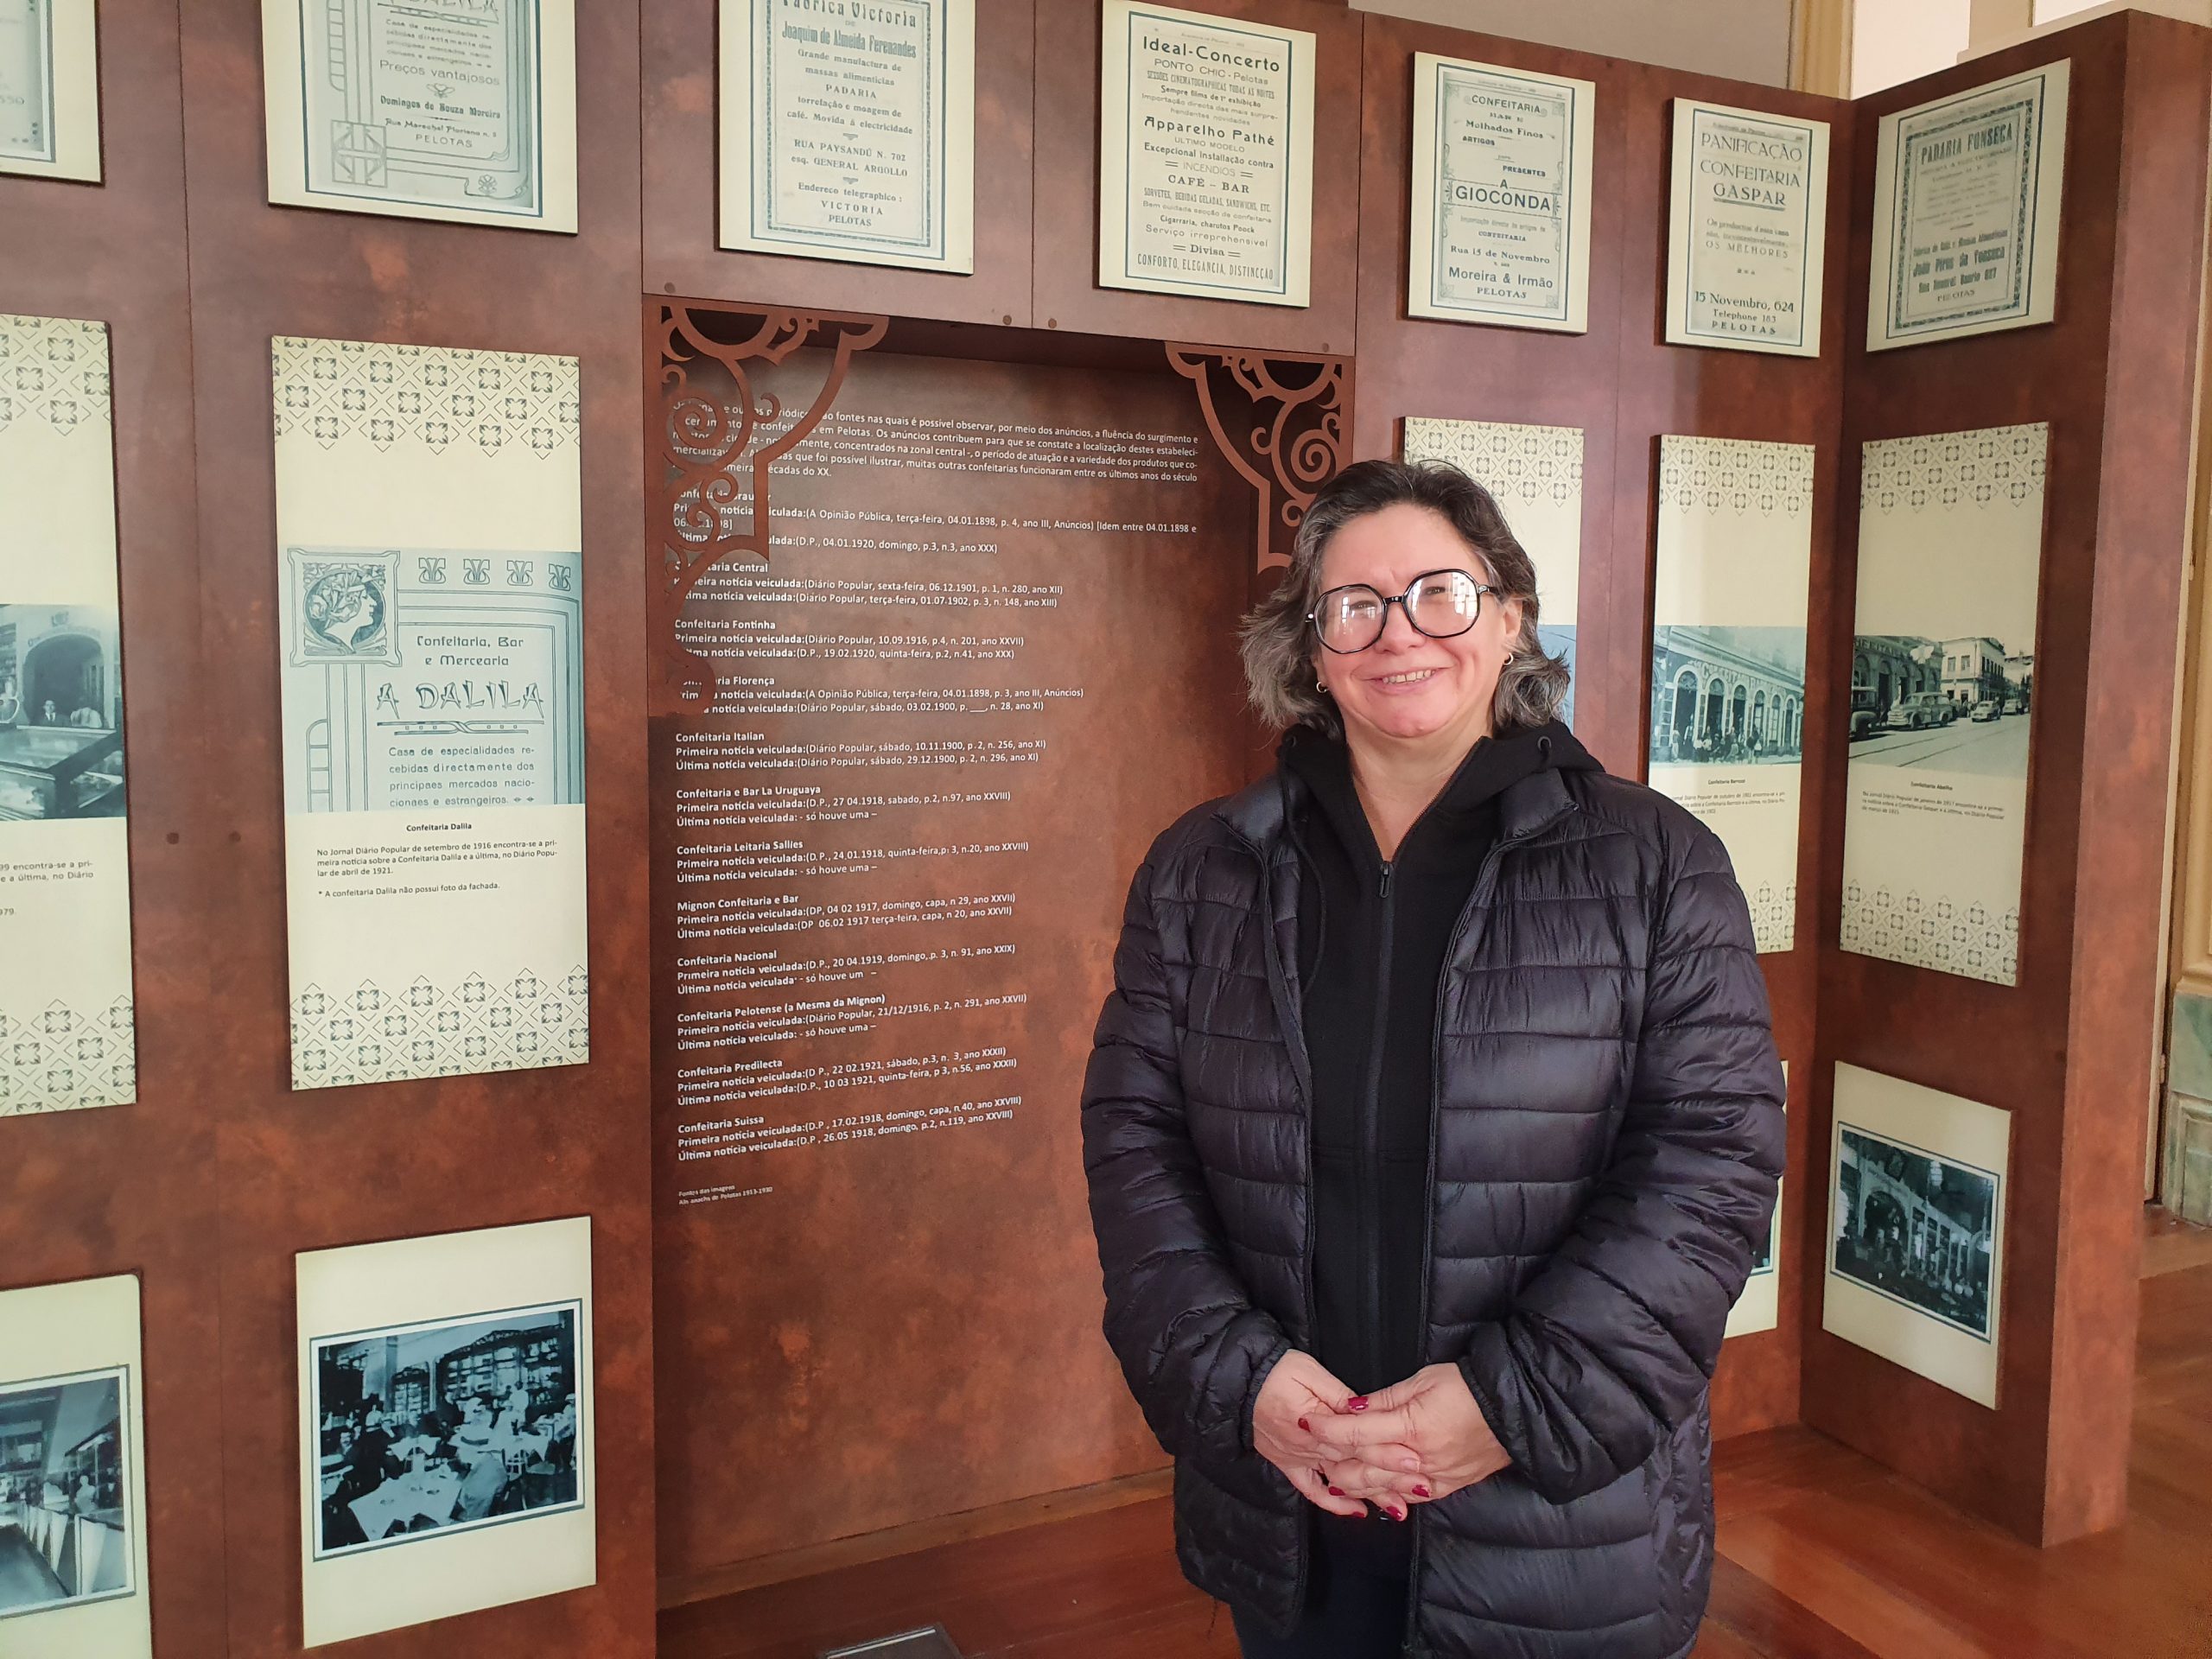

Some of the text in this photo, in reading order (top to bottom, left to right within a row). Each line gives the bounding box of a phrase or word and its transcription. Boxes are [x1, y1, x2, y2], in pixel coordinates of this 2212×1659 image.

[852, 4, 915, 28] Victoria
[1144, 35, 1279, 73] Ideal-Concerto
[380, 59, 499, 86] Preços vantajosos
[1154, 58, 1193, 74] PONTO
[1199, 66, 1226, 79] CHIC
[826, 84, 876, 99] PADARIA
[1471, 94, 1541, 113] CONFEITARIA
[1145, 116, 1274, 146] Apparelho Pathé
[416, 133, 473, 148] PELOTAS
[1700, 132, 1802, 162] PANIFICAÇÃO
[1922, 123, 2012, 165] PADARIA FONSECA
[1700, 160, 1801, 188] CONFEITARIA
[1168, 174, 1205, 188] CAFÉ
[1223, 181, 1249, 194] BAR
[1500, 179, 1508, 190] A
[1456, 185, 1551, 211] GIOCONDA
[1713, 182, 1786, 206] GASPAR
[821, 200, 882, 215] VICTORIA
[829, 214, 871, 227] PELOTAS
[1190, 244, 1224, 257] Divisa
[1451, 245, 1549, 264] Rua 15 de Novembro
[1449, 266, 1553, 289] Moreira & Irmão
[1477, 287, 1527, 299] PELOTAS
[1710, 292, 1770, 312] Novembro,
[1774, 301, 1794, 314] 624
[1712, 321, 1776, 335] PELOTAS
[676, 619, 775, 630] Confeitaria Fontinha
[417, 635, 524, 648] Confeitaria, Bar
[441, 655, 508, 666] Mercearia
[377, 679, 544, 720] A DALILA
[677, 731, 764, 742] Confeitaria Italian
[389, 747, 415, 757] Casa
[421, 747, 433, 756] de
[441, 745, 515, 757] especialidades
[677, 745, 719, 757] Primeira
[722, 744, 754, 755] notícia
[839, 742, 876, 755] Popular,
[879, 741, 913, 753] sábado,
[916, 741, 964, 753] 10.11.1900,
[968, 741, 985, 751] p.2,
[998, 740, 1014, 750] 256,
[1035, 739, 1046, 750] XI)
[390, 761, 534, 773] cebidas directamente dos
[391, 778, 535, 792] principaes mercados nacio-
[677, 788, 733, 798] Confeitaria
[743, 787, 760, 797] Bar
[762, 787, 772, 796] La
[775, 786, 820, 798] Uruguaya
[390, 798, 429, 808] cionaes
[406, 823, 448, 831] Confeitaria
[677, 815, 709, 827] Última
[713, 815, 746, 825] notícia
[748, 811, 797, 823] veiculada:
[806, 810, 816, 821] só
[819, 811, 847, 820] houve
[677, 842, 731, 855] Confeitaria
[734, 842, 770, 852] Leitaria
[333, 888, 373, 897] confeitaria
[376, 887, 397, 895] Dalila
[415, 885, 438, 894] possui
[469, 882, 500, 891] fachada.
[677, 900, 715, 912] Mignon
[718, 895, 772, 908] Confeitaria
[783, 895, 798, 904] Bar
[677, 950, 776, 967] Confeitaria Nacional
[677, 994, 885, 1023] Confeitaria Pelotense (a Mesma da Mignon)
[678, 1024, 720, 1037] Primeira
[722, 1020, 754, 1033] notícia
[838, 1008, 875, 1021] Popular,
[878, 1003, 931, 1016] 21/12/1916,
[944, 1001, 951, 1010] 2,
[965, 998, 982, 1007] 291,
[1002, 993, 1027, 1004] XXVII)
[677, 1059, 783, 1078] Confeitaria Predilecta
[678, 1116, 764, 1134] Confeitaria Suissa
